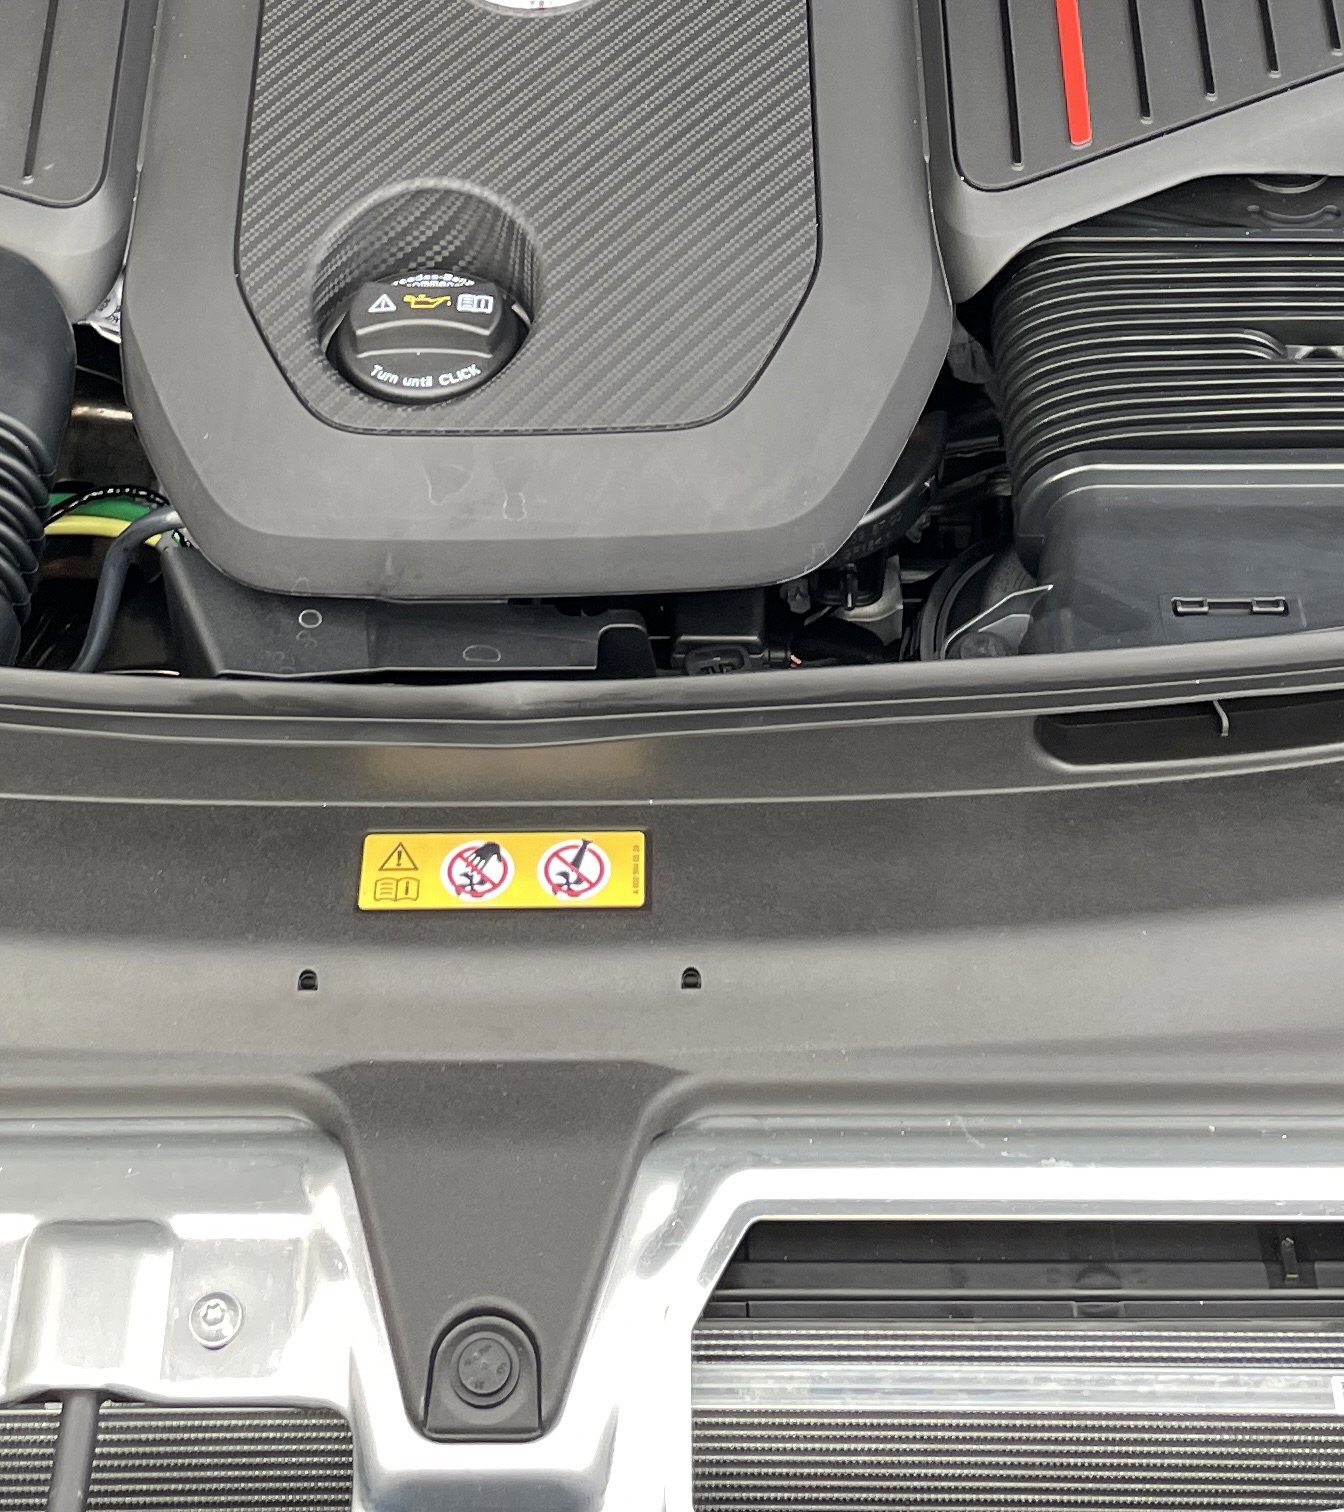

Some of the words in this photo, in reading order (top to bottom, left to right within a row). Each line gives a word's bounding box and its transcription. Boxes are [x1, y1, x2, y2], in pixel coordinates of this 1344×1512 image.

[370, 364, 400, 385] Turn
[403, 374, 433, 388] until
[438, 363, 482, 387] CLICK
